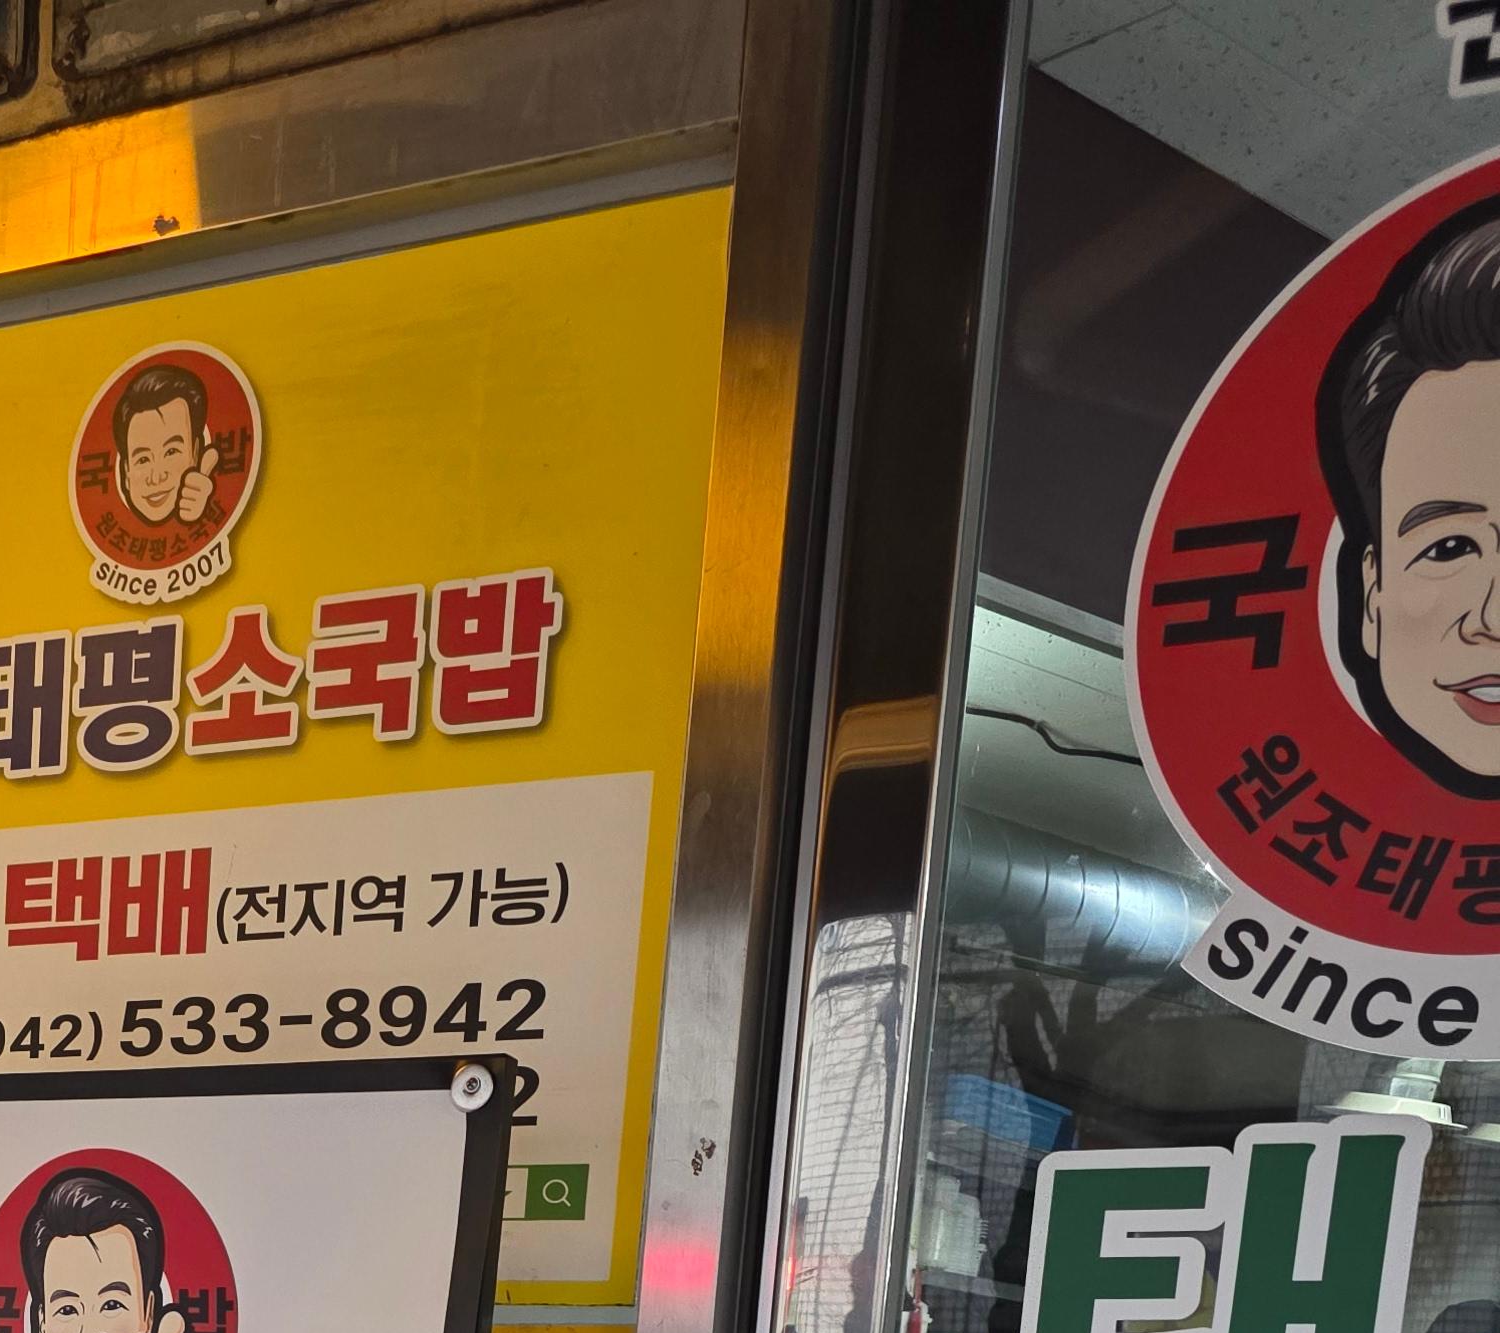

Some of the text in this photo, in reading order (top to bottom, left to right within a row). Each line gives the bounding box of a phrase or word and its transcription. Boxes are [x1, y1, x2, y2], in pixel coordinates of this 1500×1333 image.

[96, 541, 226, 596] since 2007
[1152, 514, 1307, 670] 국
[4, 846, 213, 963] 택배
[426, 861, 571, 928] 가능)
[1207, 918, 1480, 1047] since
